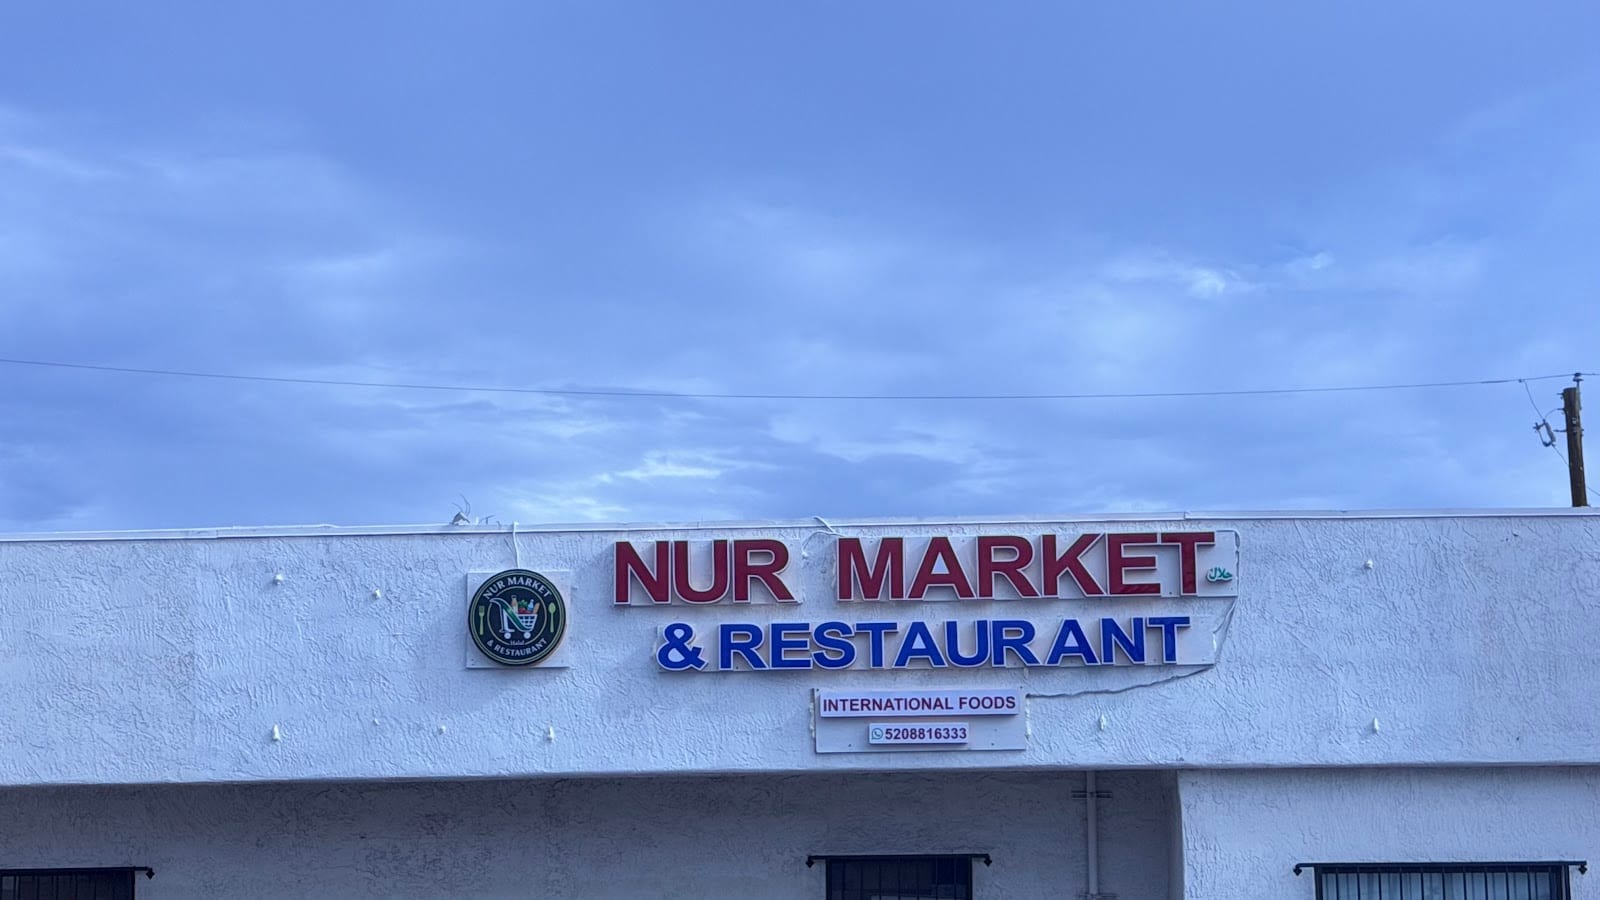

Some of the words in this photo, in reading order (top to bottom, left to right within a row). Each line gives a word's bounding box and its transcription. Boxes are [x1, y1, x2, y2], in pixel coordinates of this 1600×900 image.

[614, 539, 800, 605] NUR
[837, 531, 1216, 601] MARKET
[1208, 566, 1233, 580] حلال
[483, 580, 505, 600] NUR
[508, 576, 552, 598] MARKET
[486, 639, 494, 648] &
[494, 638, 548, 657] RESTAURANT
[656, 622, 708, 670] &
[718, 616, 1191, 670] RESTAURANT
[823, 697, 954, 712] INTERNATIONAL
[959, 695, 1016, 710] FOODS
[885, 727, 967, 740] 5208816333
